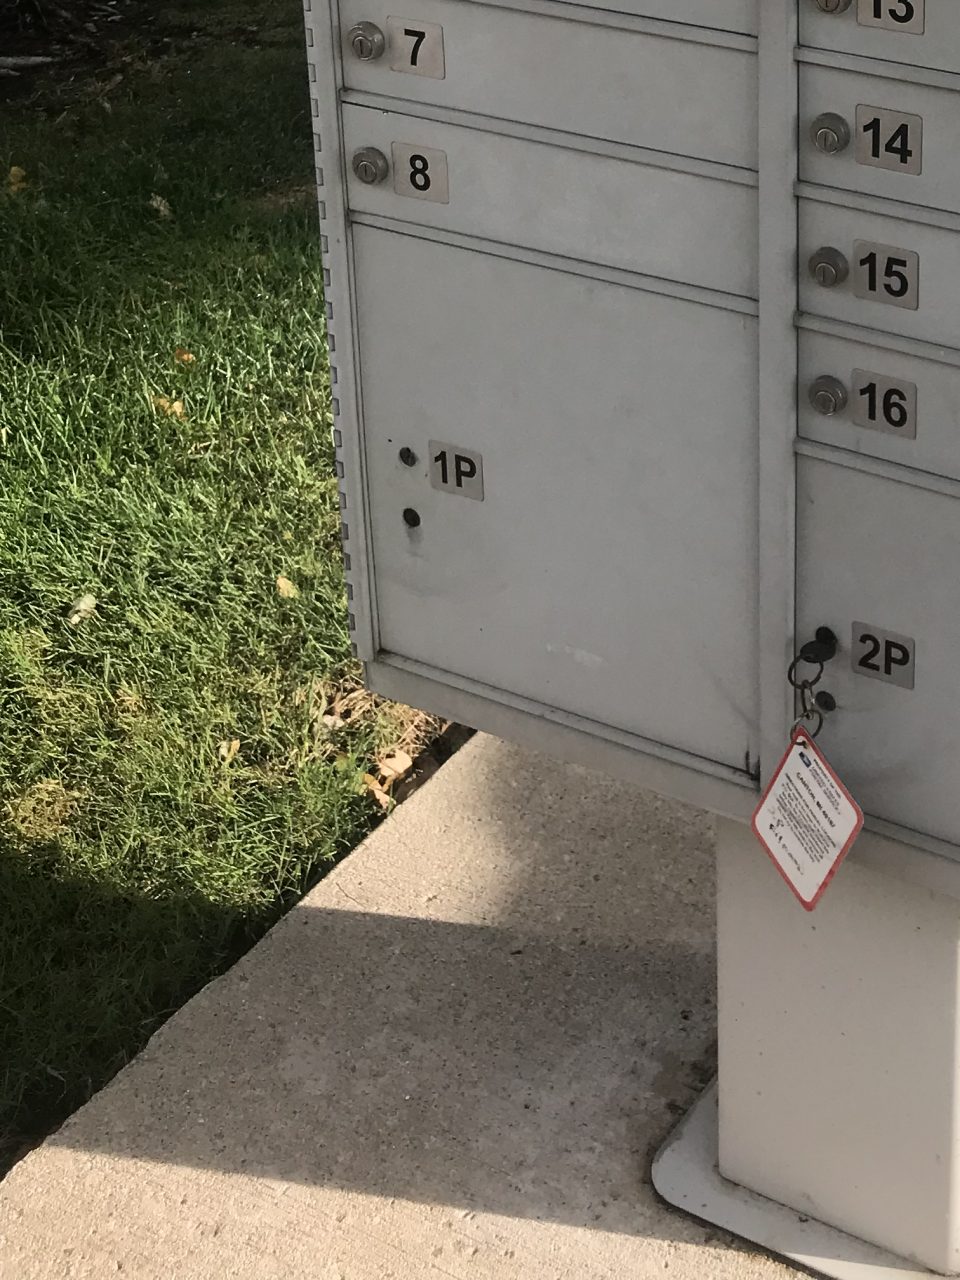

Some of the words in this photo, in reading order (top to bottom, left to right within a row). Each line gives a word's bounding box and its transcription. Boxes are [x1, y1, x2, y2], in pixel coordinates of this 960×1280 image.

[403, 28, 426, 67] 7
[862, 117, 913, 165] 14
[409, 154, 431, 192] 8
[859, 251, 909, 298] 15
[859, 382, 908, 428] 16
[433, 450, 477, 488] 1P
[859, 633, 910, 676] 2P
